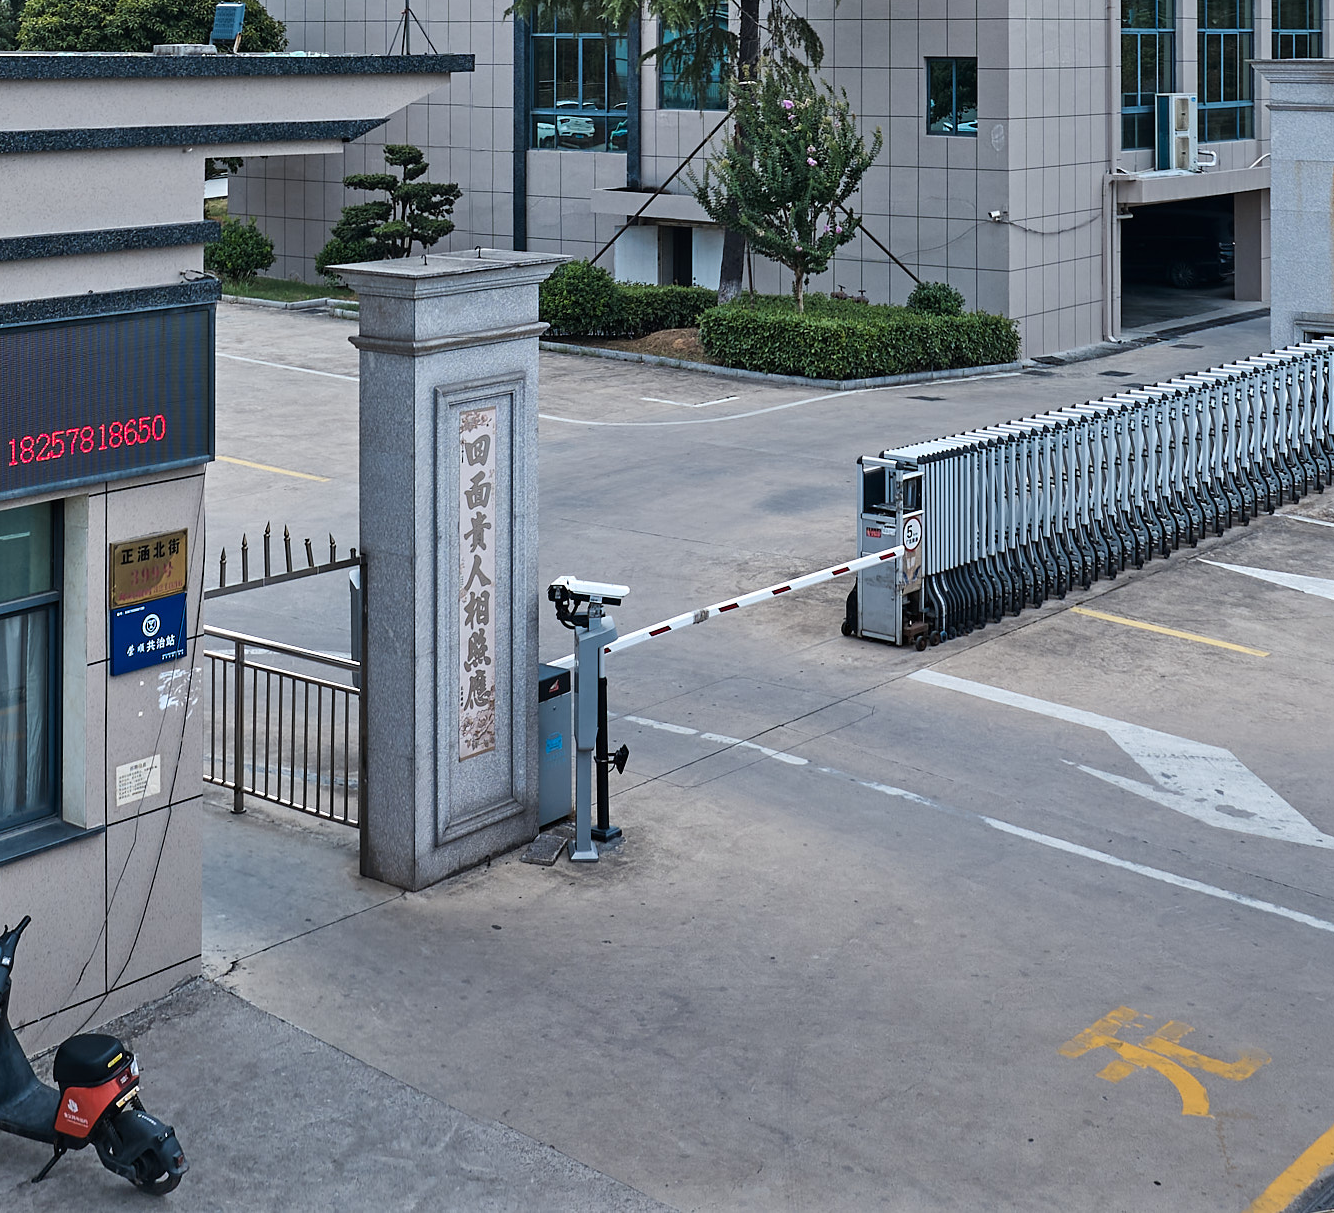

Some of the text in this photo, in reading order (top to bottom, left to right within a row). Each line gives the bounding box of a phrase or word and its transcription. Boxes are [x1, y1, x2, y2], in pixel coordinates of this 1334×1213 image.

[7, 414, 167, 467] 18257818650
[120, 538, 181, 566] 正涵北街
[130, 561, 174, 586] 399号
